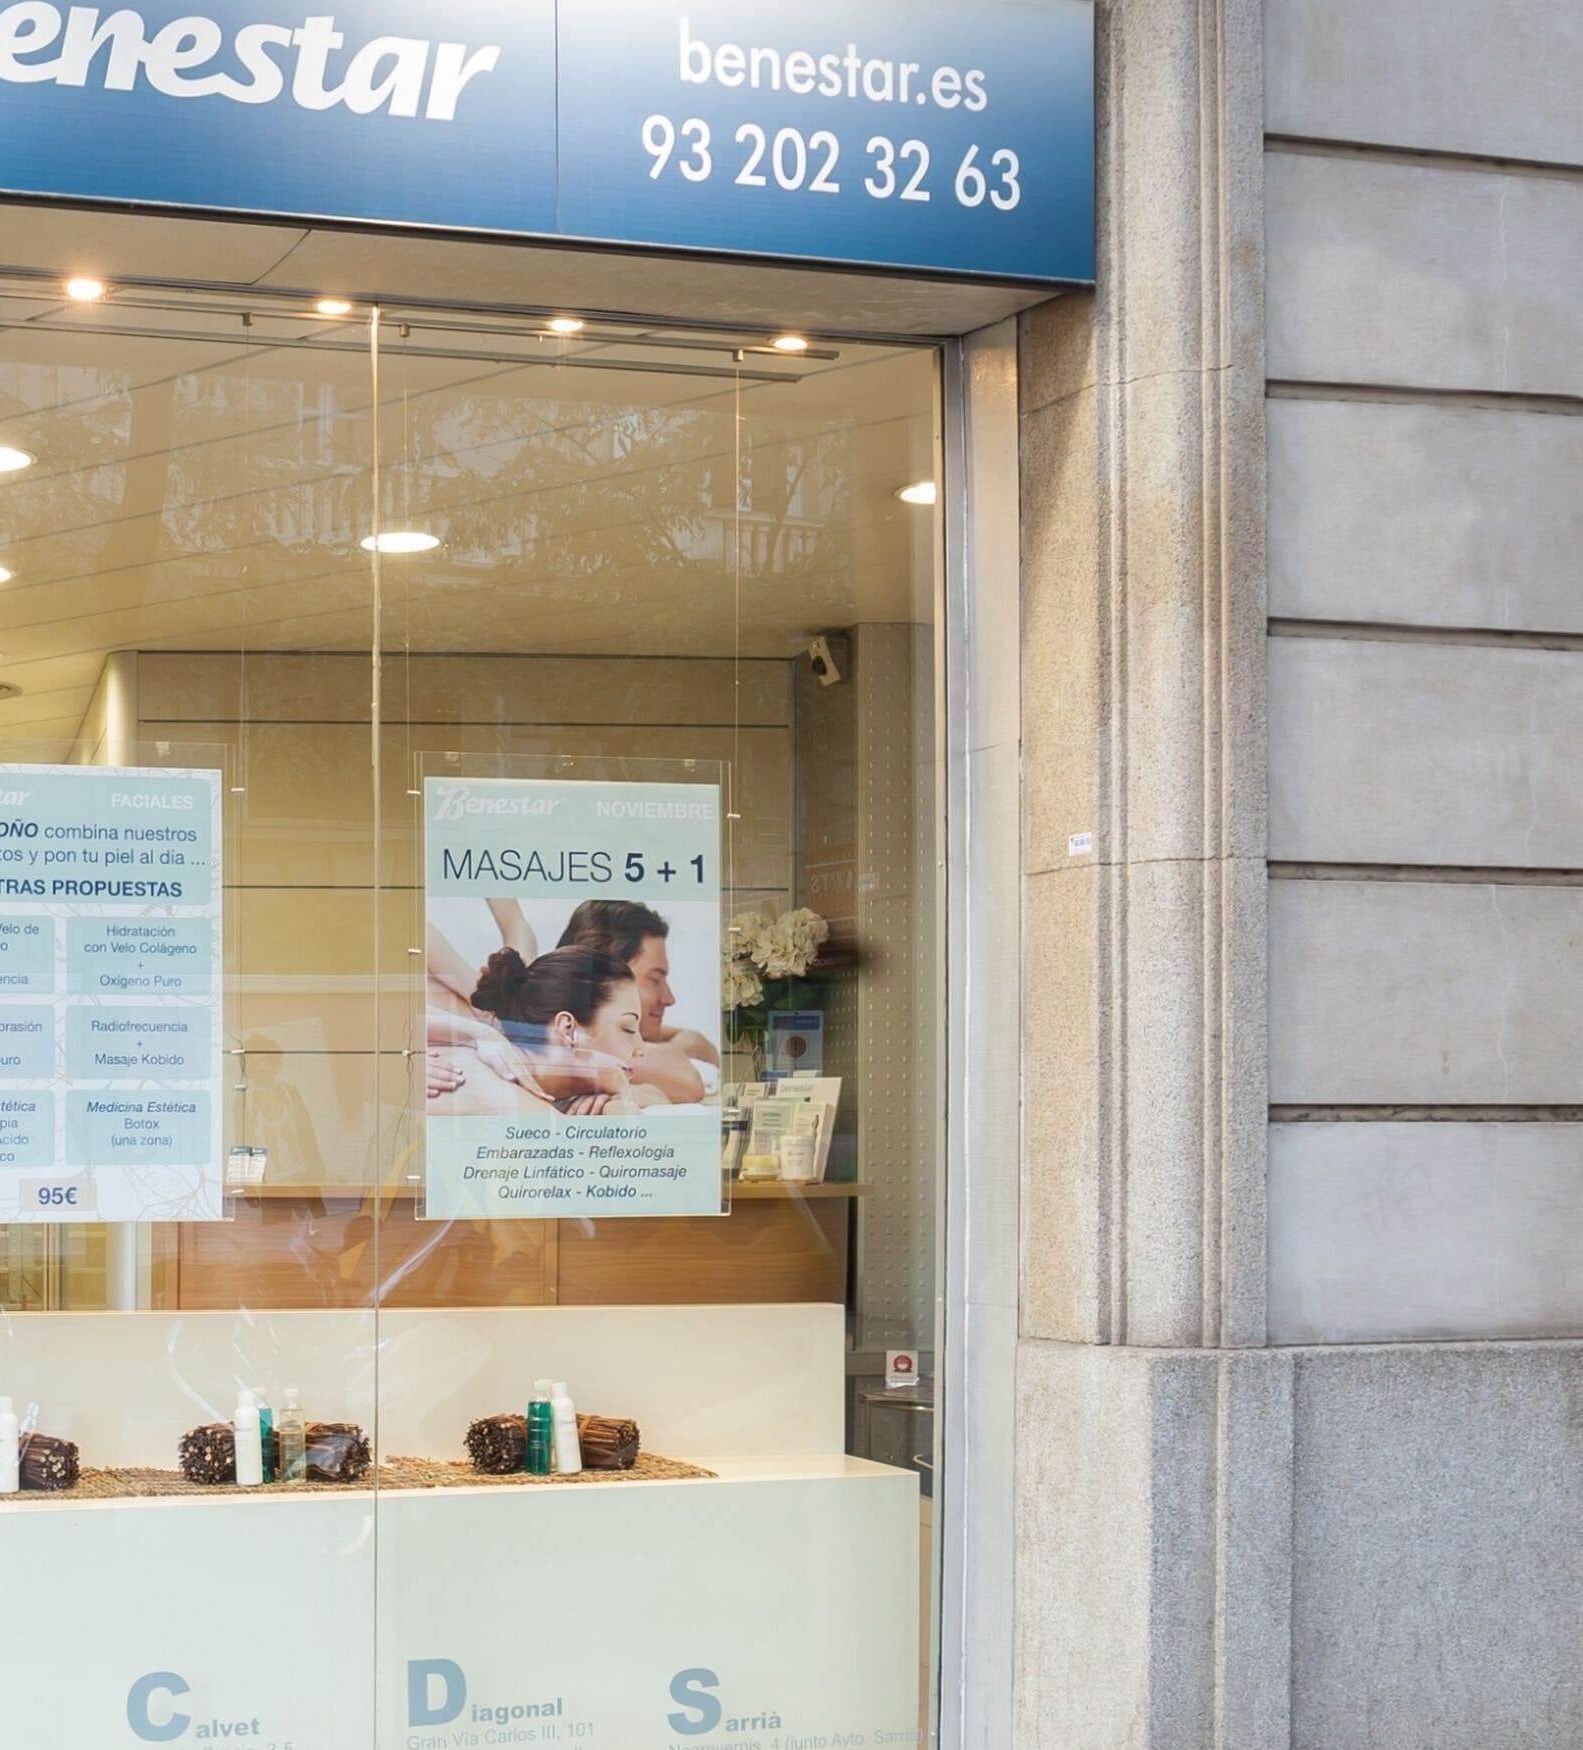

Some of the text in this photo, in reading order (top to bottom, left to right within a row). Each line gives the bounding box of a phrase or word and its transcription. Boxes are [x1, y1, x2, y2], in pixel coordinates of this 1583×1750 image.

[679, 16, 988, 112] benestar.es
[641, 114, 1021, 211] 93 202 32 63
[111, 793, 195, 810] FACIALES
[433, 786, 561, 821] Benestar
[596, 801, 715, 821] NOVIEMBRE
[44, 823, 119, 841] combina
[124, 826, 197, 842] nuestros
[29, 849, 39, 865] y
[44, 850, 77, 866] pon
[82, 848, 99, 864] tu
[104, 847, 134, 867] piel
[140, 849, 154, 865] al
[443, 848, 704, 884] MASAJES 5 + 1
[52, 879, 183, 898] PROPUESTAS
[24, 924, 40, 936] de
[106, 925, 175, 938] Hidratación
[84, 942, 197, 957] con Velo Colágeno
[99, 974, 182, 989] Oxígeno Puro
[91, 1020, 189, 1033] Radiofrecuencia
[94, 1053, 185, 1068] Masaje Kobido
[86, 1101, 196, 1113] Medicina Estética
[124, 1118, 160, 1130] Botox
[505, 1126, 550, 1140] Sueco
[565, 1125, 647, 1140] Circulatorio
[111, 1134, 173, 1148] (una zona)
[476, 1145, 574, 1160] Embarazadas
[463, 1165, 519, 1183] Drenaje
[523, 1164, 584, 1179] Linfático
[599, 1165, 687, 1183] Quiromasaje
[38, 1187, 78, 1206] 95€
[498, 1185, 571, 1200] Quirorelax
[586, 1185, 636, 1199] Kobido
[407, 1658, 563, 1726] Diagonal
[667, 1667, 782, 1735] Sarrià
[126, 1671, 261, 1742] Calvet
[407, 1735, 448, 1750] Gran
[484, 1727, 536, 1745] Carlos
[568, 1722, 595, 1737] 101
